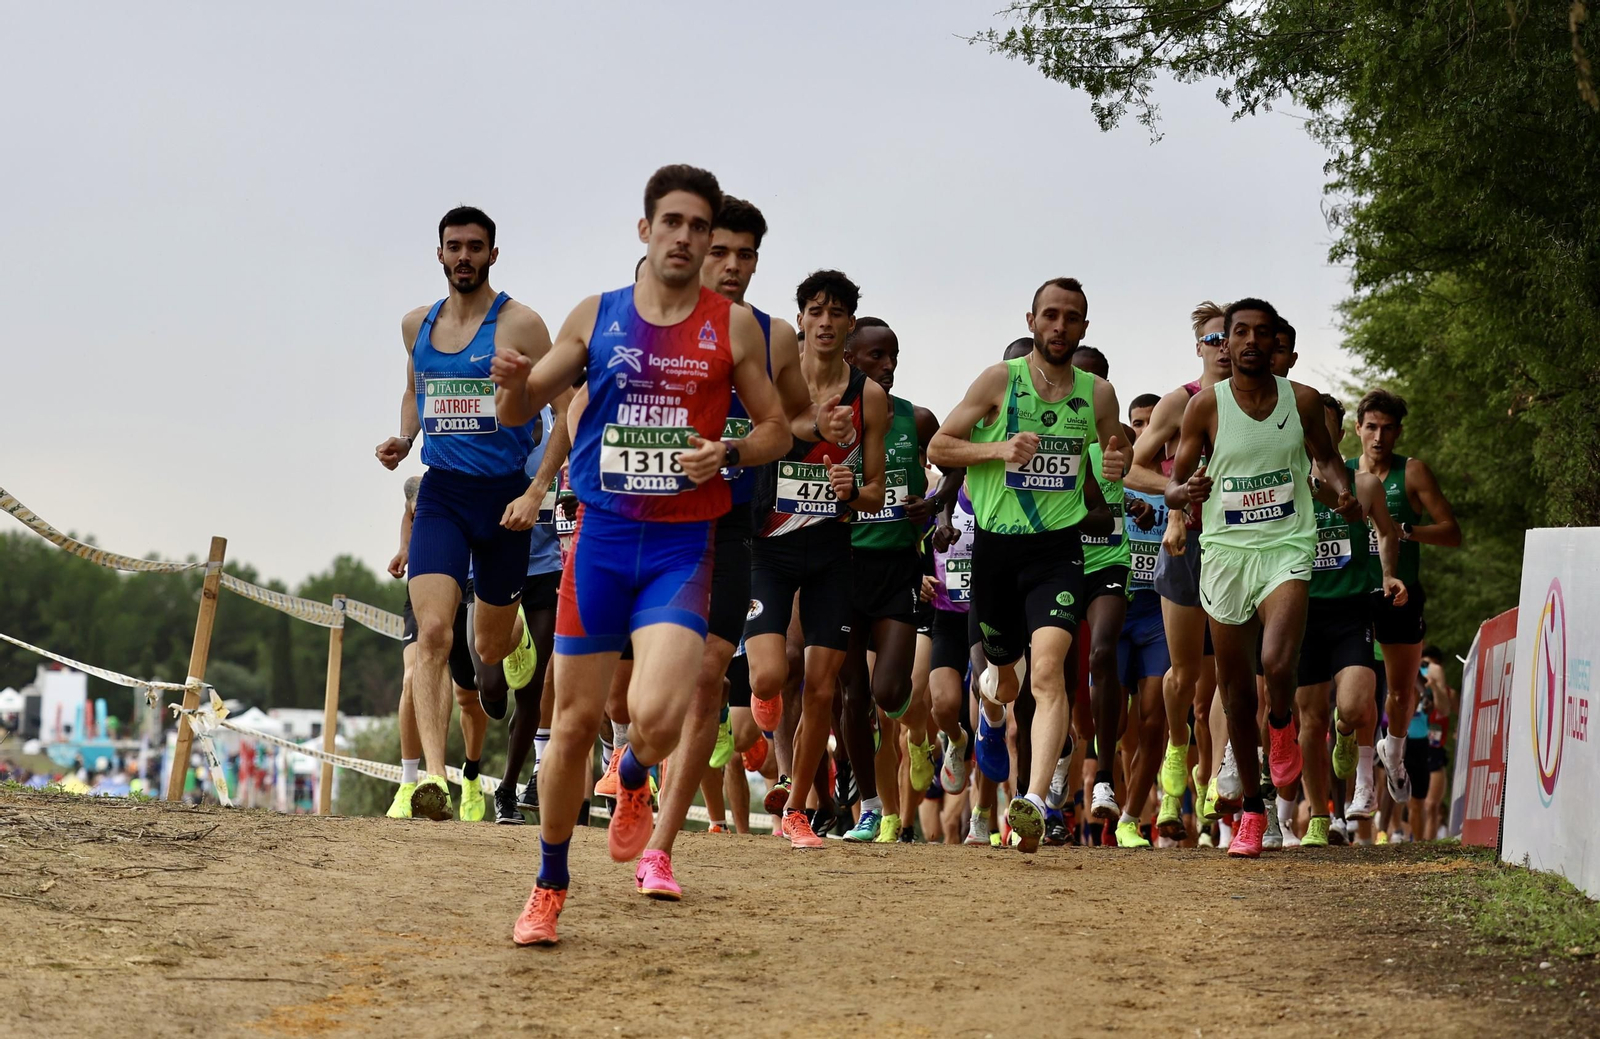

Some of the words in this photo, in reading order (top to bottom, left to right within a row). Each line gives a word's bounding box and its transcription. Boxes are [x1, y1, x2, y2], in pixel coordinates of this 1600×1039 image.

[648, 353, 709, 371] lapalma
[666, 368, 708, 378] cooperativa
[437, 383, 479, 394] ITÁLICA
[434, 398, 481, 414] CATROFE
[626, 393, 681, 405] ATLETISMO
[617, 403, 689, 426] DELSUR
[1066, 417, 1088, 425] Unicaja
[623, 429, 681, 445] ITÁLICA
[1036, 438, 1069, 452] ÁLICA
[619, 450, 684, 473] 1318
[1018, 455, 1071, 475] 2065
[797, 465, 830, 478] ITÁLI
[1236, 475, 1279, 489] ITÁLICA
[797, 483, 837, 501] 478
[1242, 489, 1277, 507] AYELE
[1130, 543, 1160, 553] ITÁLIC
